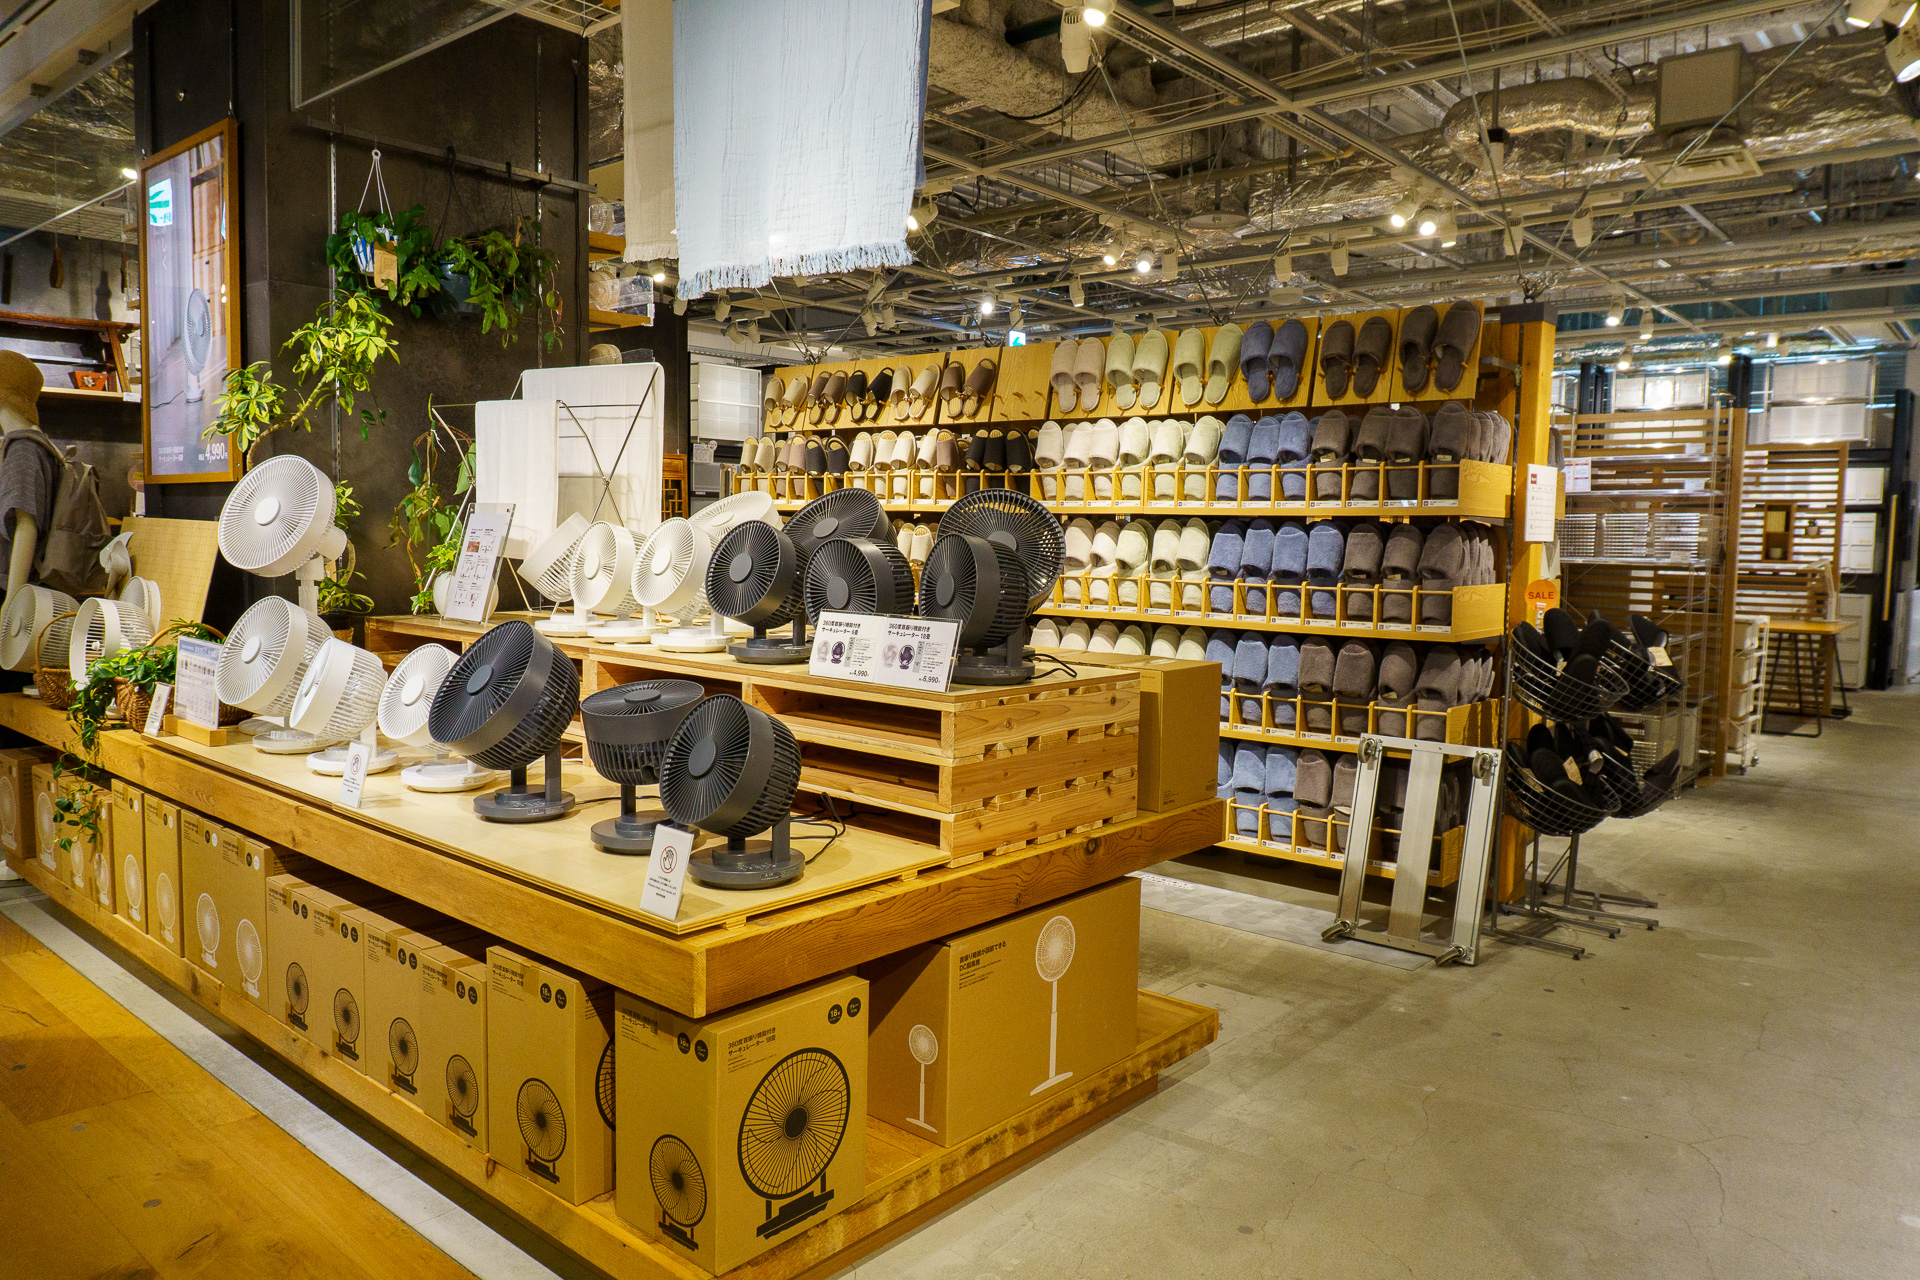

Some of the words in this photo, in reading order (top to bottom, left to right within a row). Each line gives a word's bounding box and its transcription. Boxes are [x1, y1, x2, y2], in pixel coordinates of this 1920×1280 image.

[1528, 591, 1554, 600] SALE
[888, 630, 919, 638] サーキュレーター
